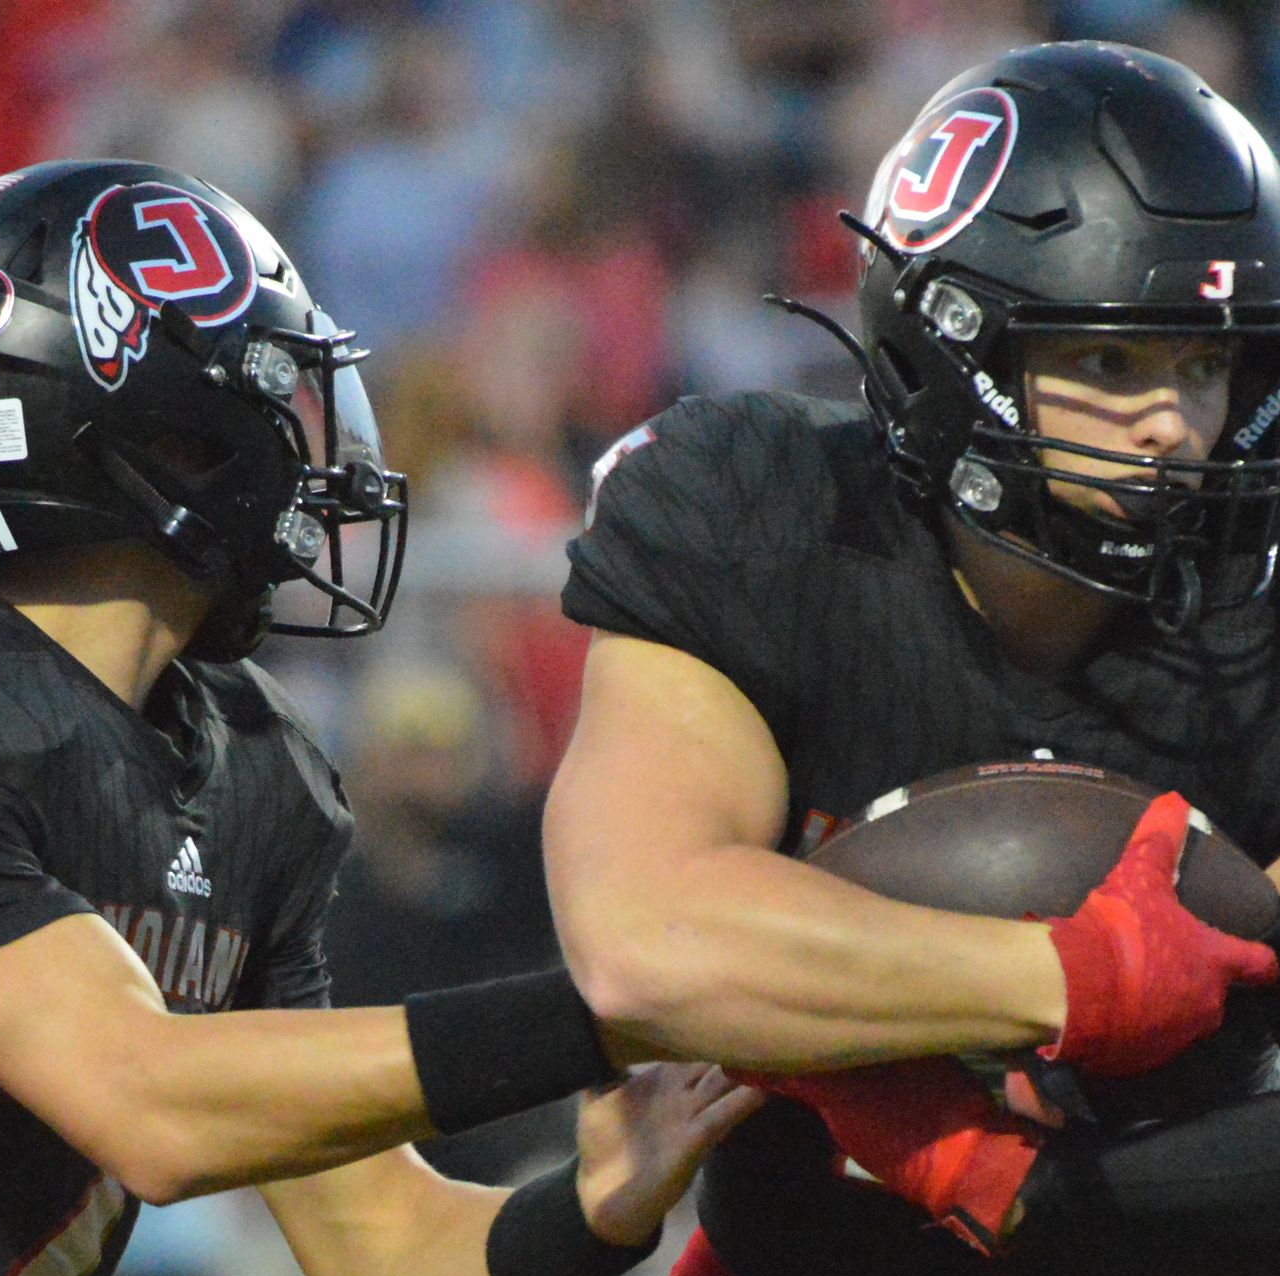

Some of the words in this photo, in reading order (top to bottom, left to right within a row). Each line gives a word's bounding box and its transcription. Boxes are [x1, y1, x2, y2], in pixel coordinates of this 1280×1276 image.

[889, 110, 1004, 222] J
[129, 197, 234, 300] J
[1200, 260, 1236, 299] J
[167, 870, 212, 898] adidas
